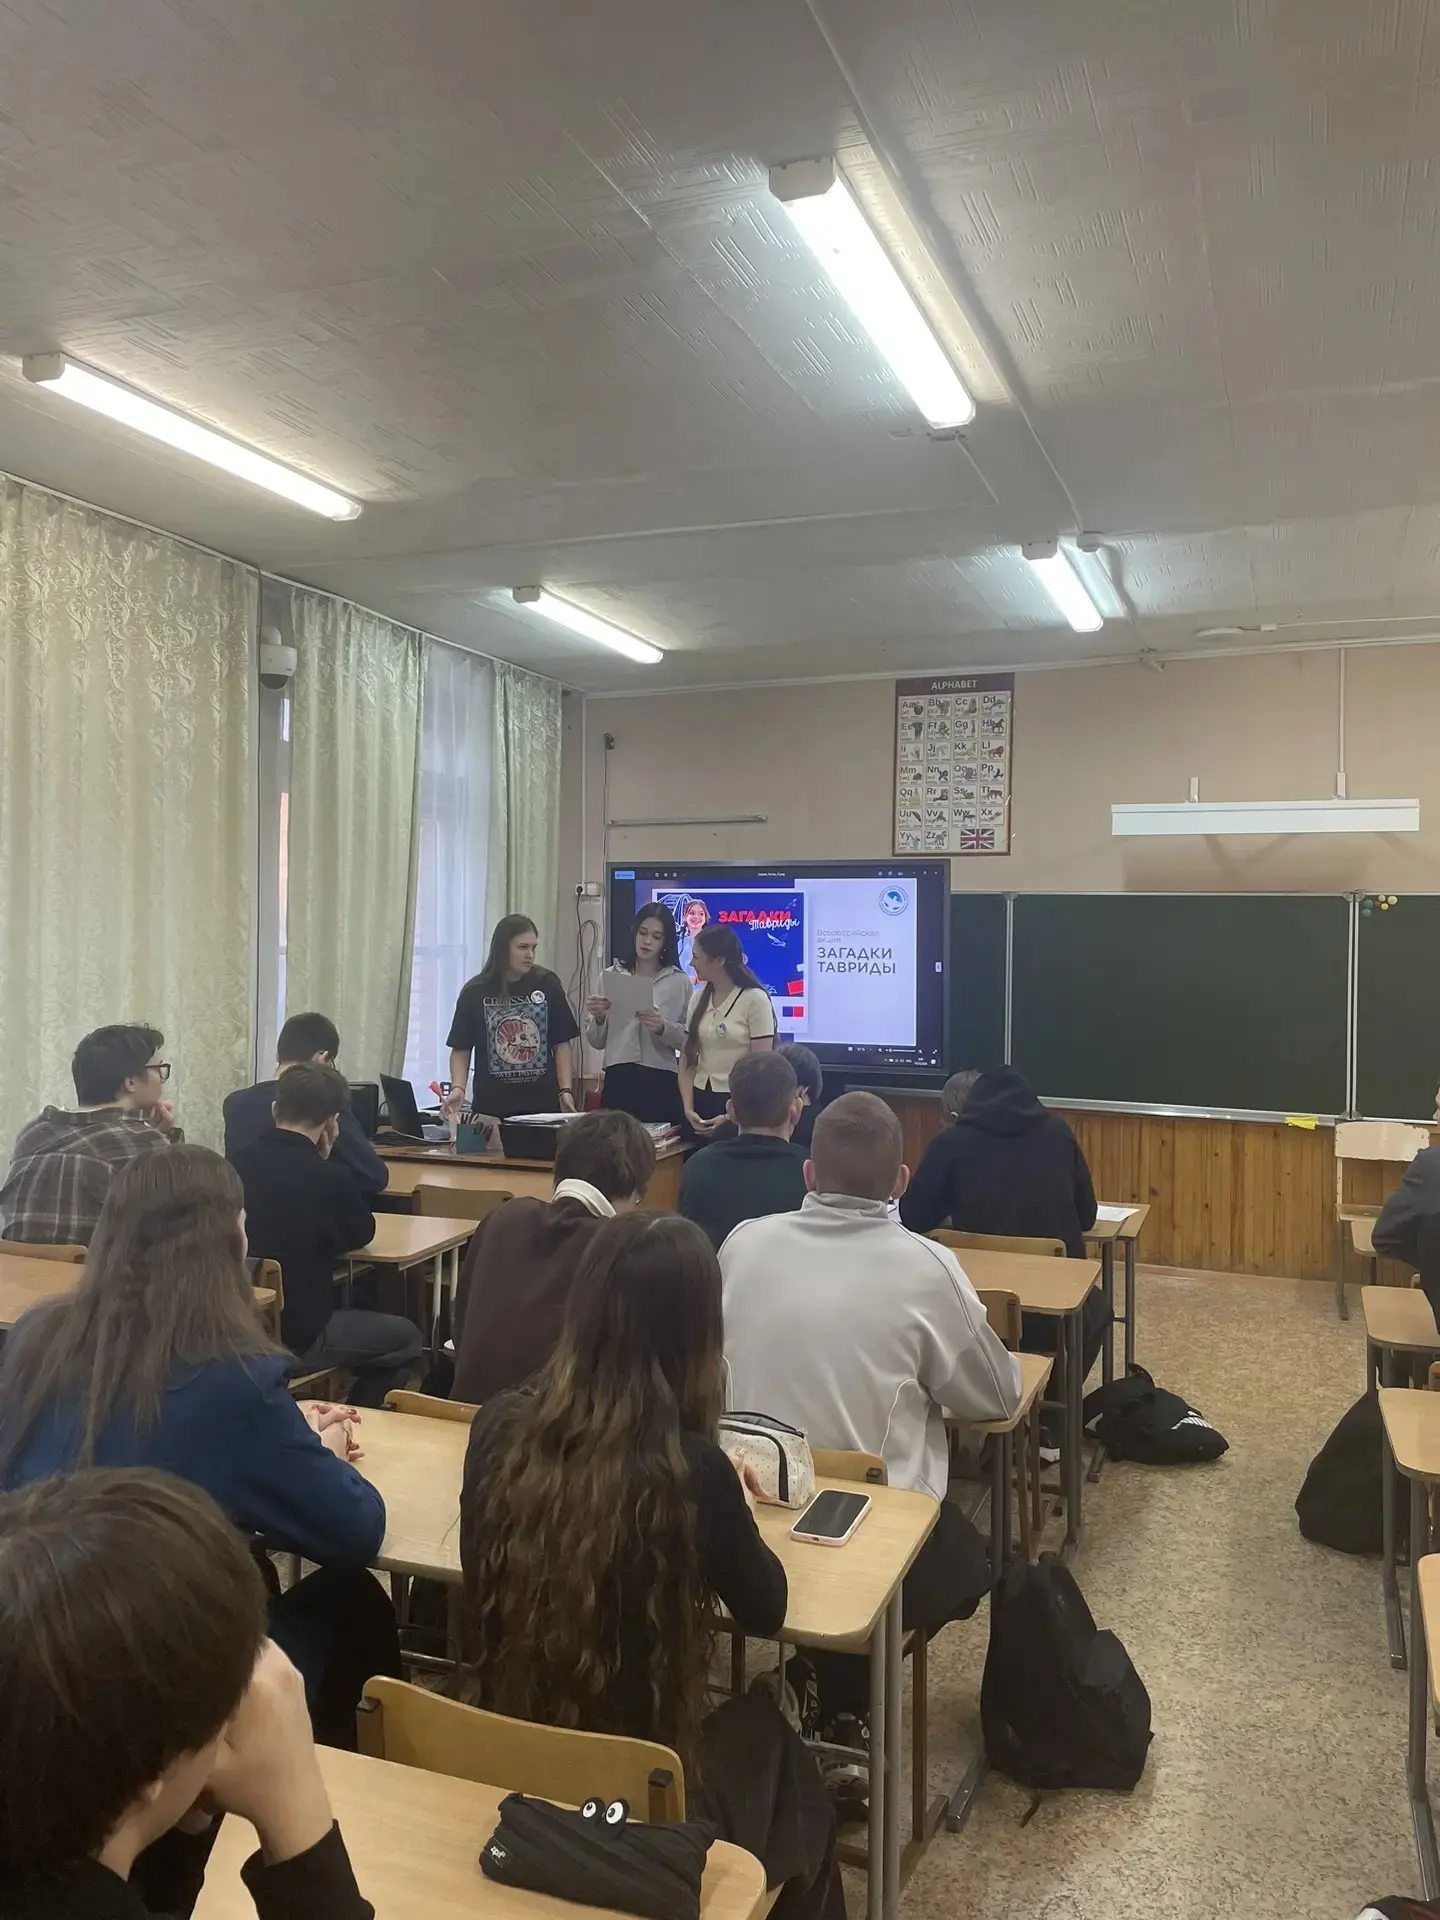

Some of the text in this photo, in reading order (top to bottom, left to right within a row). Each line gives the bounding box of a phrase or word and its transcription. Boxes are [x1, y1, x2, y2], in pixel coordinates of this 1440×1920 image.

[931, 679, 978, 691] ALPHABET
[983, 696, 996, 704] Dd
[955, 720, 968, 729] Gg
[928, 744, 936, 752] Jj
[954, 742, 967, 750] Kk
[954, 764, 967, 772] Oo
[981, 763, 994, 773] Pp
[900, 788, 913, 797] Qq
[954, 787, 966, 795] Ss
[926, 809, 938, 817] Vv
[981, 808, 993, 816] Xx
[899, 832, 911, 841] Yy
[926, 831, 936, 839] Zz
[718, 910, 791, 923] ЗАГАДКИ
[749, 917, 800, 931] Тавриды
[817, 929, 880, 937] Всероссийская
[817, 947, 892, 960] ЗАГАДКИ
[817, 962, 896, 976] ТАВРИДЫ
